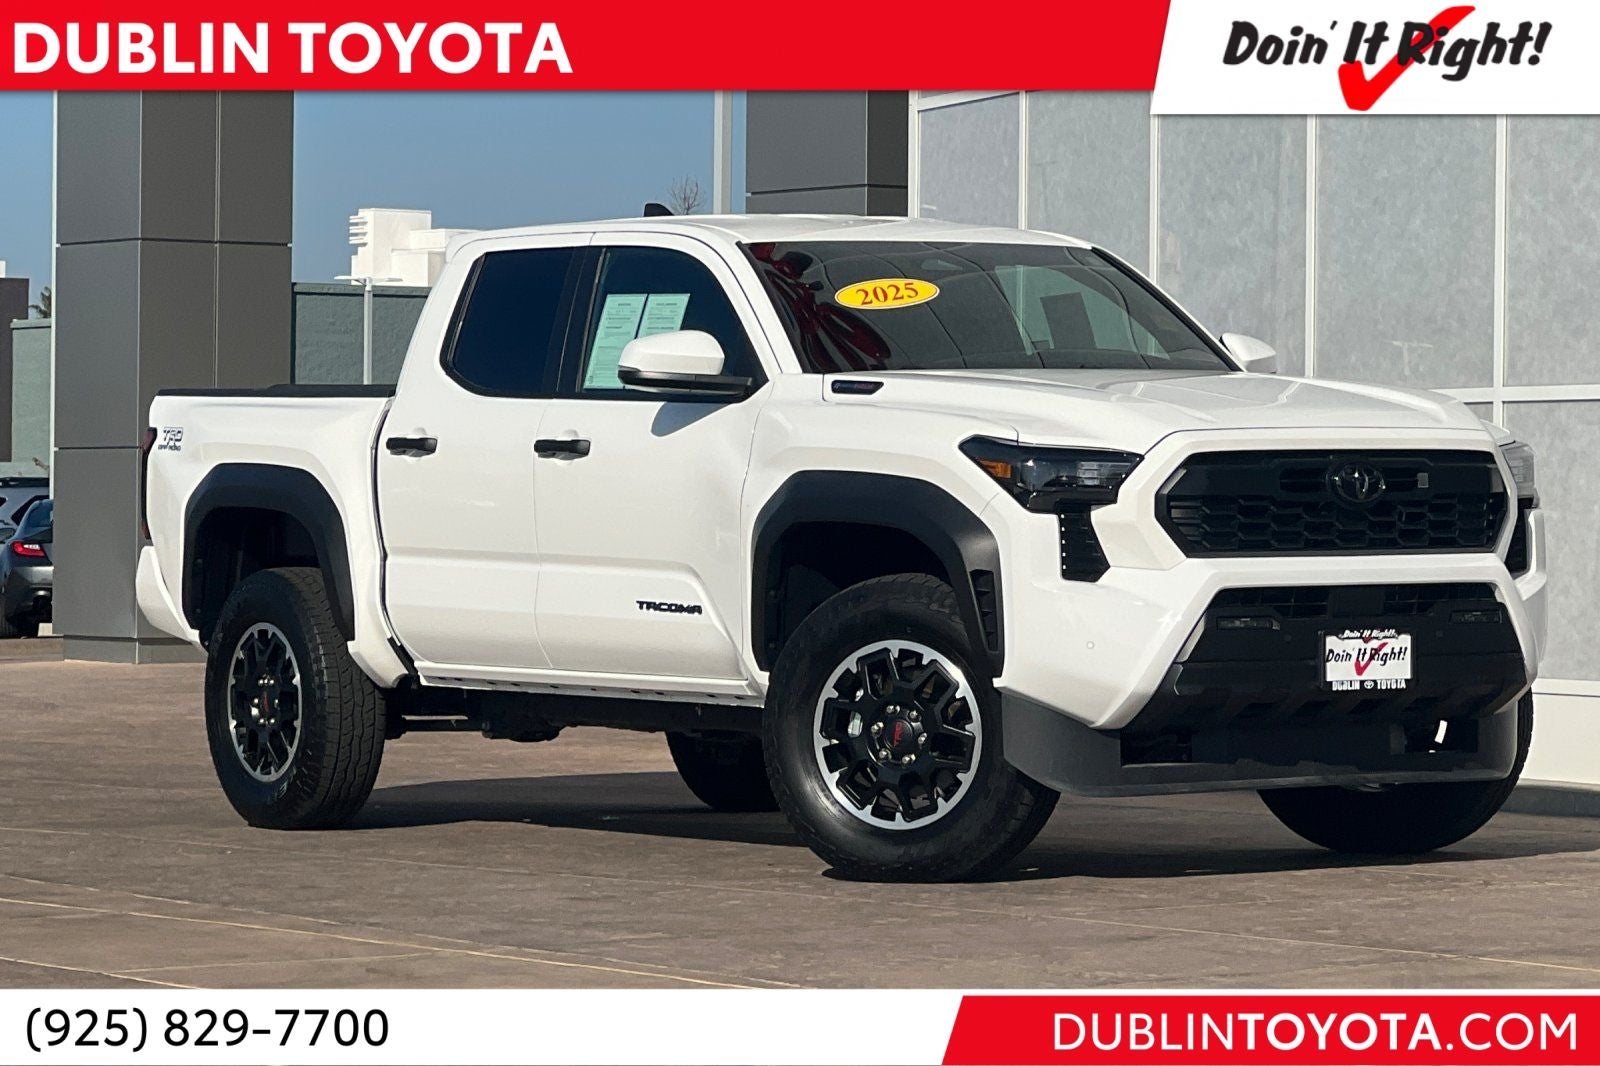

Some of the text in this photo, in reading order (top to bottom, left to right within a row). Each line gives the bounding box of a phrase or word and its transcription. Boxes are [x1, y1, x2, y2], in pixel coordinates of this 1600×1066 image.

[855, 281, 920, 306] 2025
[635, 600, 703, 615] TACOMA
[1356, 647, 1368, 662] It
[1369, 646, 1408, 667] Right!
[1332, 679, 1407, 691] DUBLIN TOYOTA
